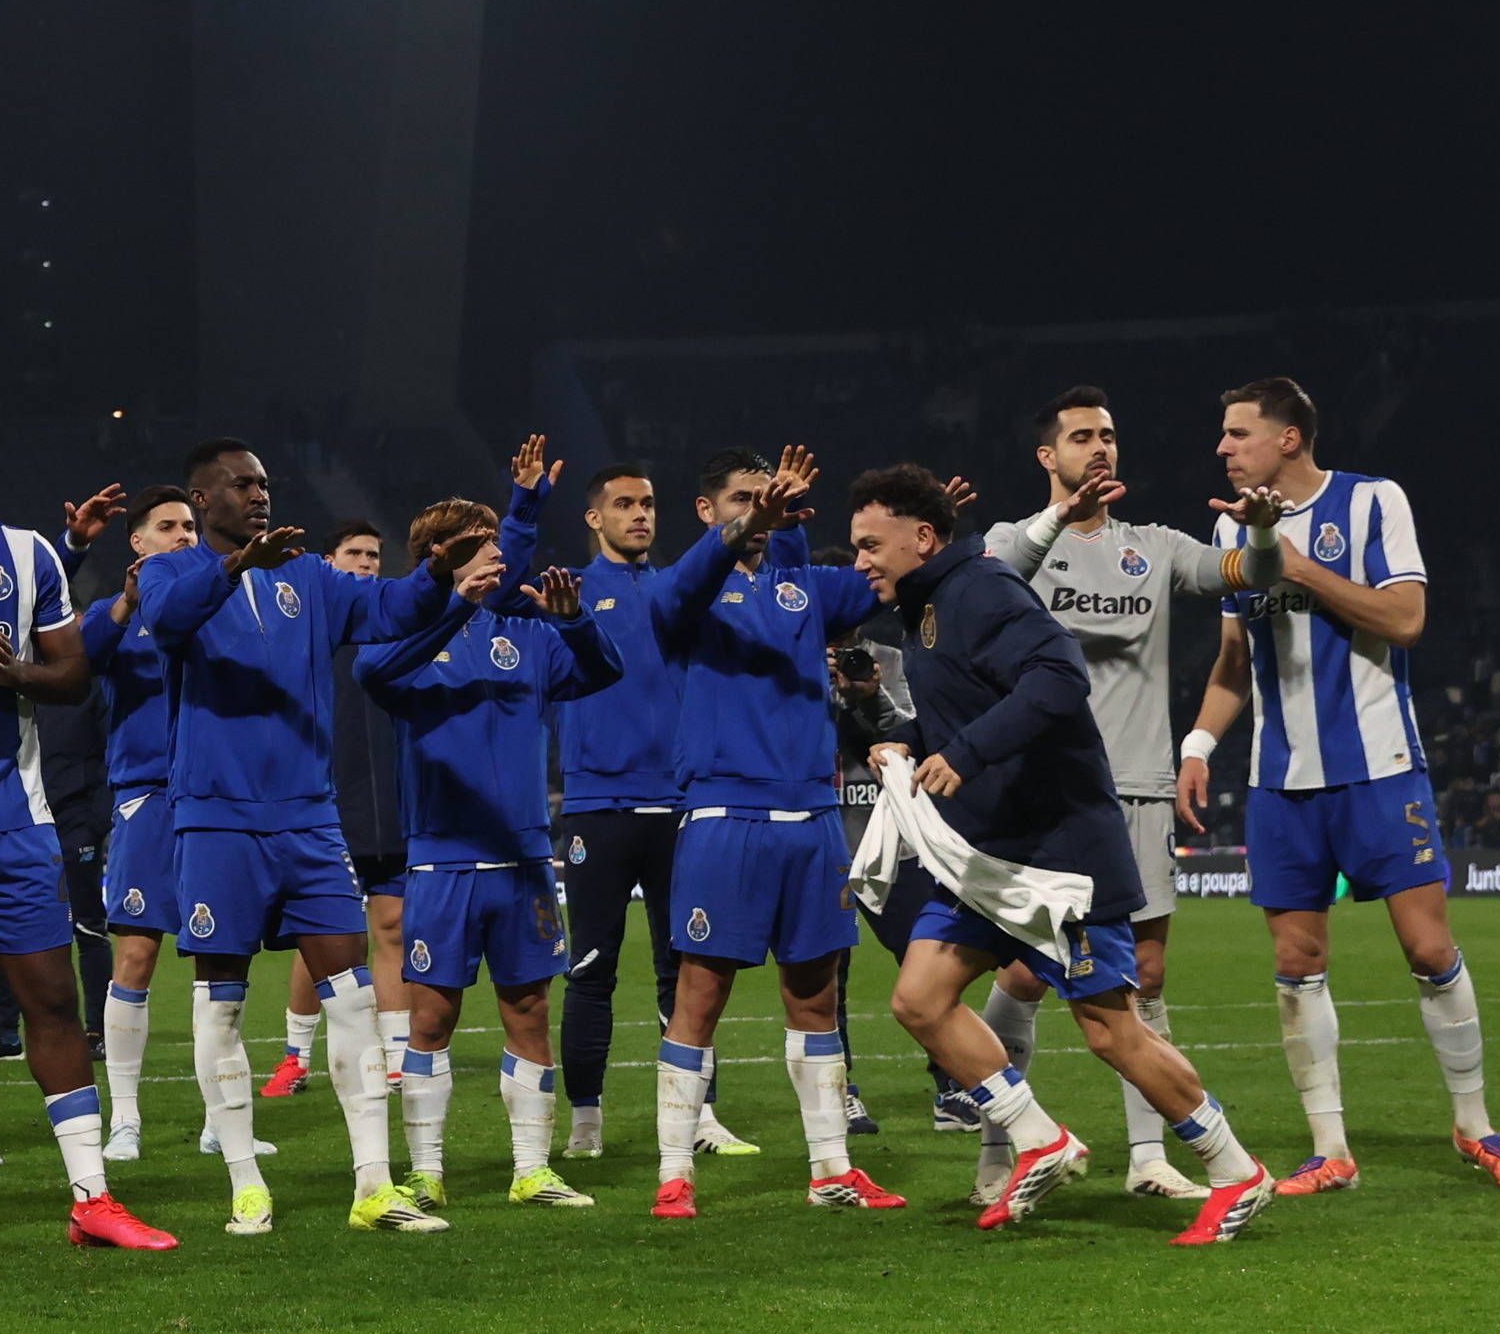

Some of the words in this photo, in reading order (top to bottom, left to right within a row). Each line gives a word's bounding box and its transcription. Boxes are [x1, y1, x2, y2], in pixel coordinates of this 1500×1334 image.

[1050, 586, 1152, 615] Betano
[1248, 592, 1321, 618] Betan
[1404, 801, 1430, 846] 5
[1190, 871, 1201, 893] e
[1201, 870, 1247, 897] poupa
